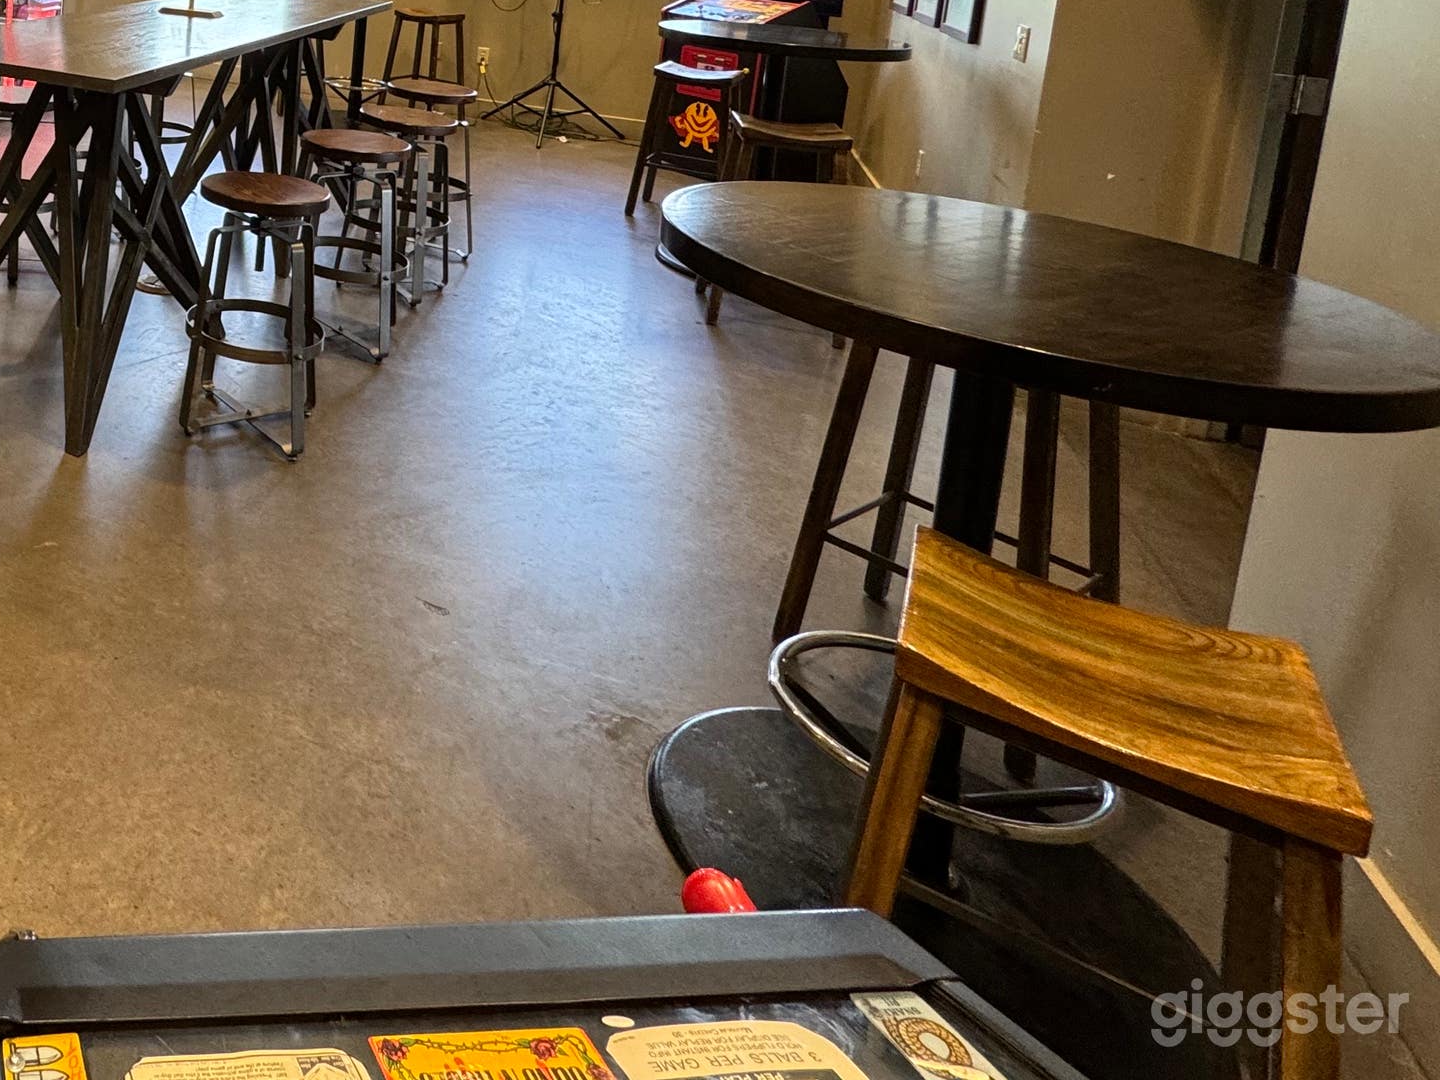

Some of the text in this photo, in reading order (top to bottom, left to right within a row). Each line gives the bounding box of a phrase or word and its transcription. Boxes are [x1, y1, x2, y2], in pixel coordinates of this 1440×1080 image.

[646, 1041, 677, 1049] VALUE
[678, 1038, 712, 1046] REPLAY
[712, 1044, 731, 1052] FOR
[732, 1042, 775, 1051] FLIPPERS
[648, 1050, 672, 1058] INFO
[673, 1046, 710, 1056] INSTANT
[647, 1051, 822, 1073] 3 BALLS PER GAME
